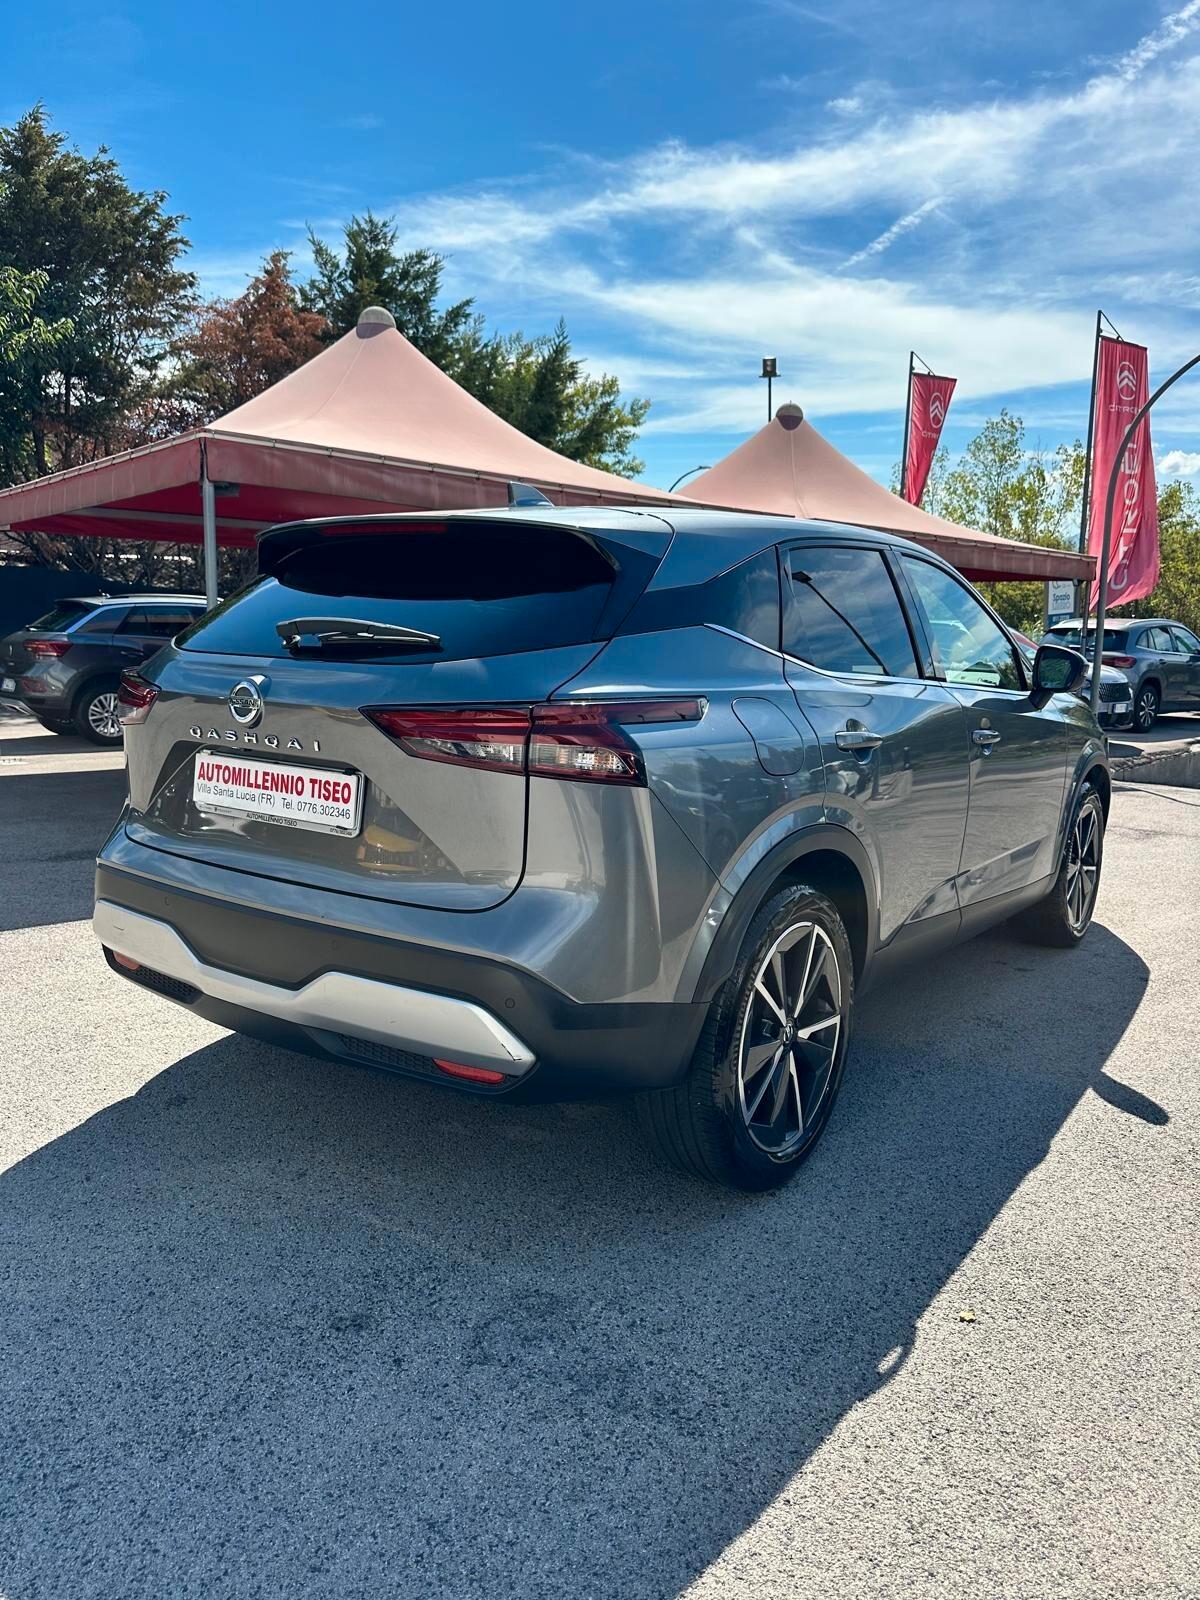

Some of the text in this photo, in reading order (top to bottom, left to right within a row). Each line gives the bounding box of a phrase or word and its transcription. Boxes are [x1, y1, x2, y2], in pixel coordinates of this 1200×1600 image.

[1108, 402, 1142, 414] CITRO
[229, 697, 258, 708] NISSAN
[189, 725, 320, 751] QASHQAI
[198, 762, 351, 804] AUTOMILLENNIO TISEO
[197, 783, 350, 819] Villa Santa Lucia (FR) Tel. 0776.302346
[246, 812, 298, 828] AUTOMILLENNIO TISEO
